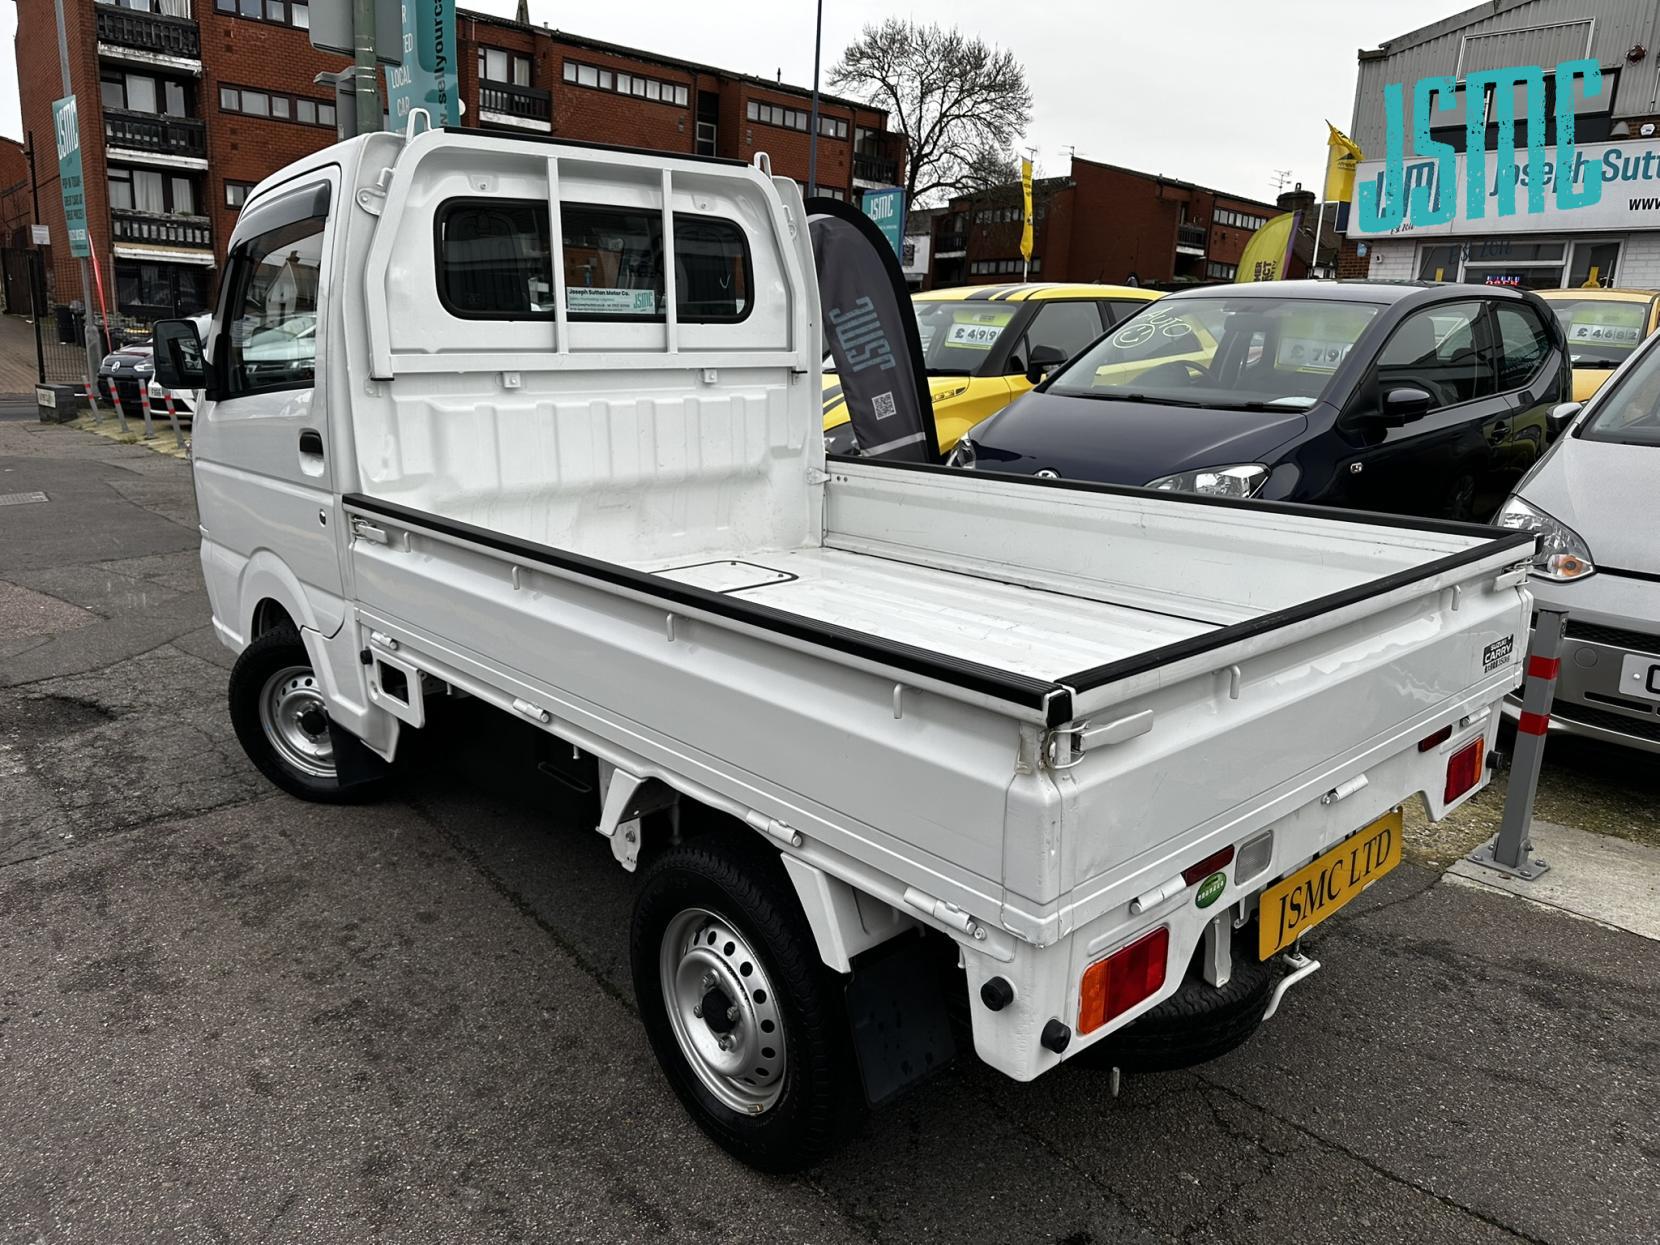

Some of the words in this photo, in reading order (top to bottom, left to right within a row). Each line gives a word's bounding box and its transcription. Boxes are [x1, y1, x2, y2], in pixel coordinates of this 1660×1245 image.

[391, 66, 412, 88] LOCAL
[954, 327, 997, 341] £499
[1485, 642, 1512, 663] CARRY
[1274, 859, 1344, 951] JSMC
[1349, 828, 1392, 888] LTD
